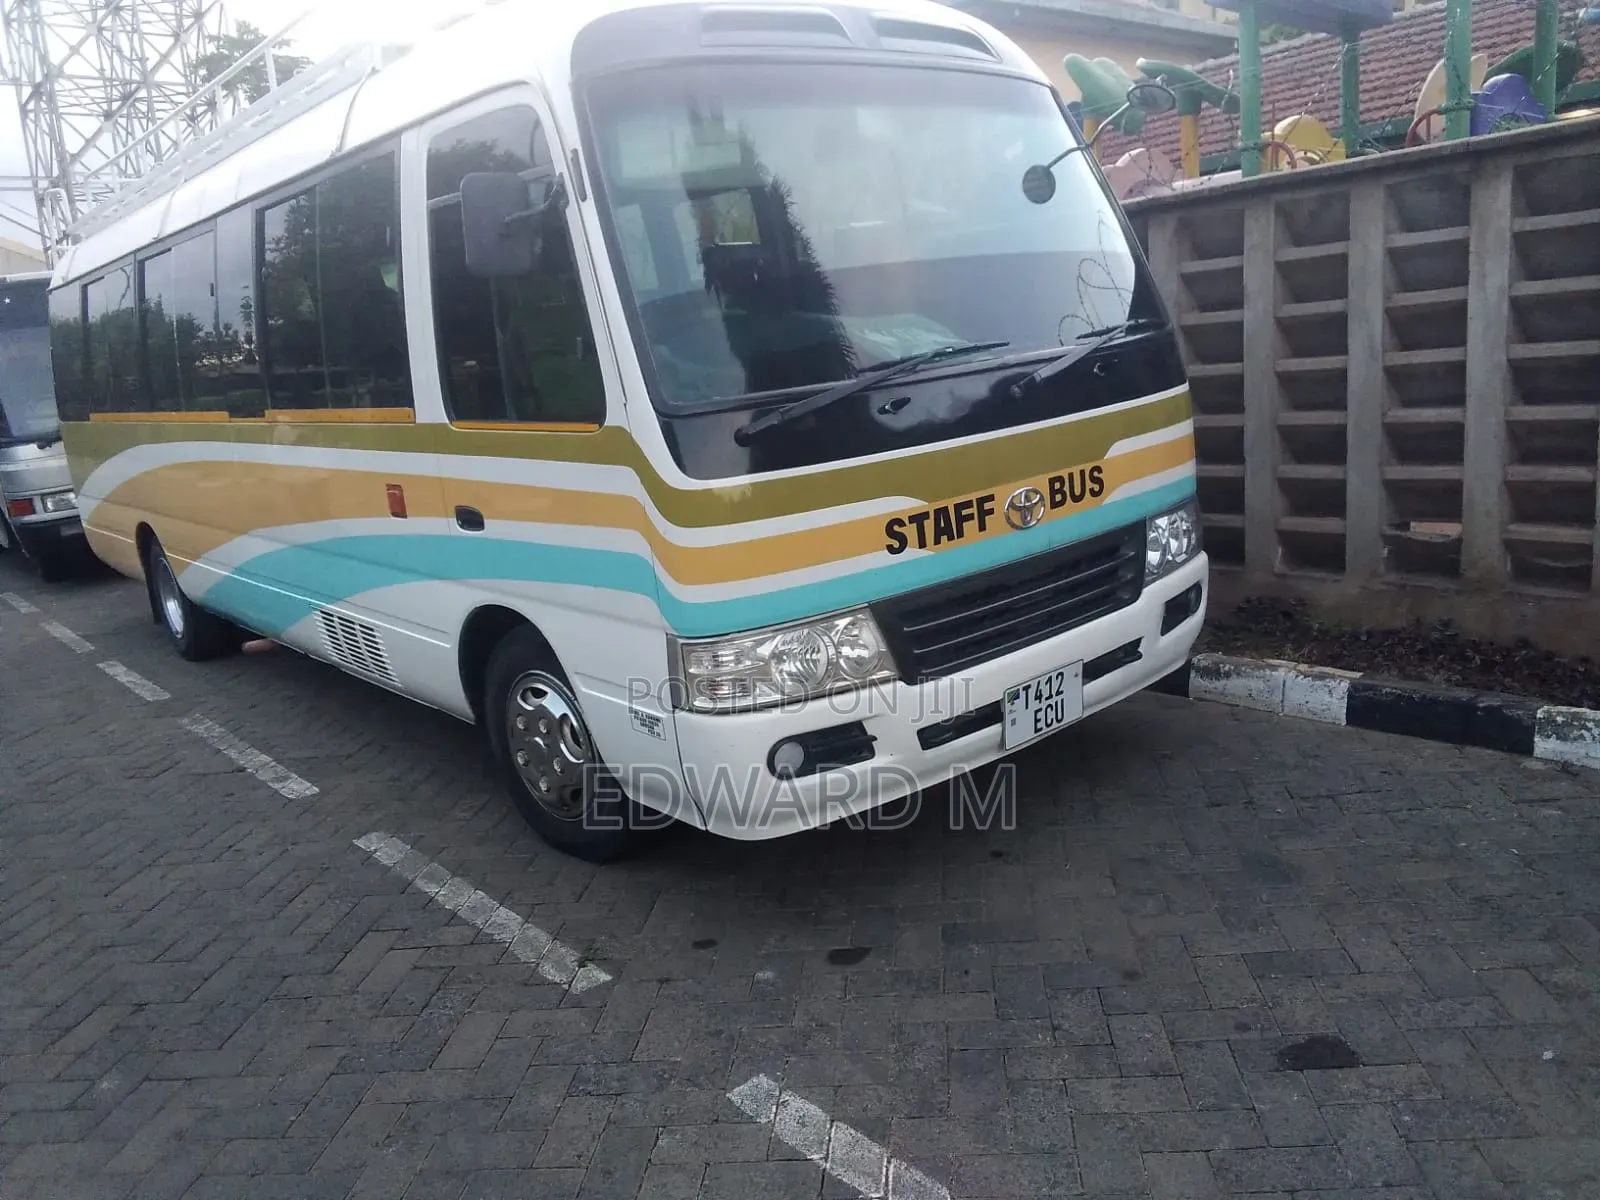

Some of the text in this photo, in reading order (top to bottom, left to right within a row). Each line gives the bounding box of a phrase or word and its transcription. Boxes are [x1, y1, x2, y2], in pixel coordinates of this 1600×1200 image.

[885, 465, 1105, 555] STAFF BUS
[1034, 698, 1065, 734] ECU
